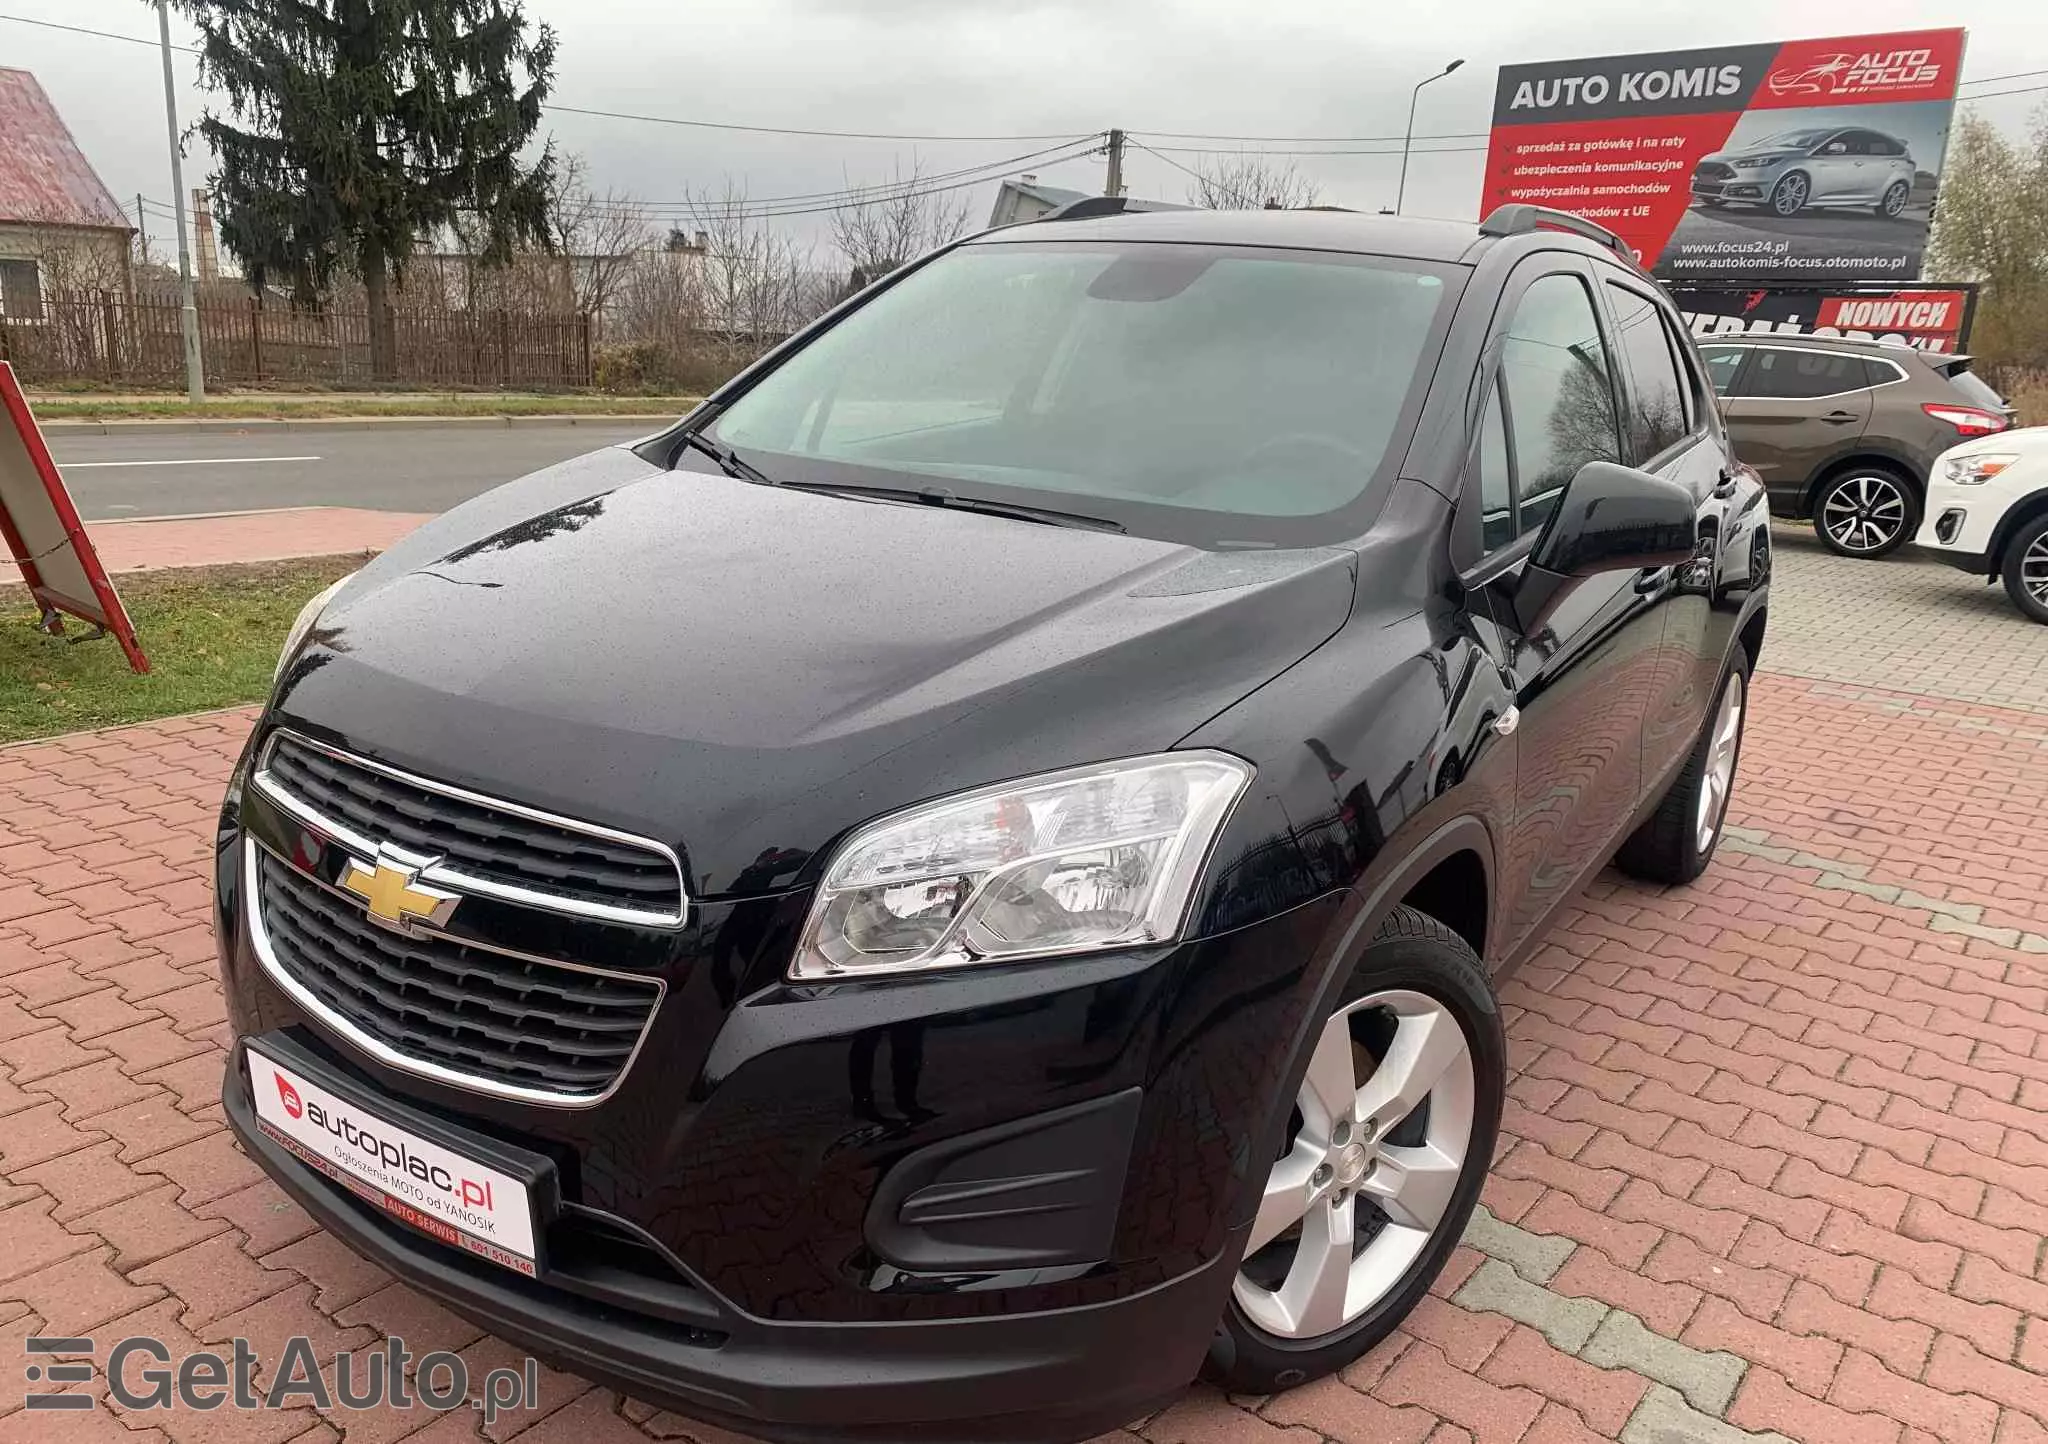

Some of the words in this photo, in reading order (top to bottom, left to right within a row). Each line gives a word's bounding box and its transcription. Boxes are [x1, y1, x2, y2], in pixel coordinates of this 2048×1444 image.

[1852, 49, 1932, 69] AUTO
[1843, 65, 1941, 86] FOCUS
[1510, 75, 1609, 110] AUTO
[1619, 65, 1742, 102] KOMIS
[1516, 141, 1566, 155] sprzedaż
[1568, 142, 1581, 152] za
[1583, 138, 1634, 153] gotówkę
[1636, 136, 1641, 148] i
[1643, 138, 1659, 148] na
[1661, 136, 1686, 149] raty
[1513, 162, 1592, 177] ubezpieczenia
[1594, 159, 1684, 173] komunikacyjne
[1511, 183, 1590, 199] wypożyczalnia
[1592, 182, 1671, 195] samochodów
[1567, 205, 1621, 218] ochodów
[1623, 207, 1629, 217] z
[1632, 205, 1650, 217] UE
[1681, 241, 1789, 255] www.focus24.pl
[1673, 255, 1907, 270] www.autokomis-focus.otomoto.pl
[1834, 301, 1952, 329] NOWYCH
[307, 1101, 494, 1212] autoplac.pl
[334, 1145, 389, 1184] Ogłoszenia
[392, 1175, 424, 1201] MOTO
[426, 1196, 441, 1210] od
[446, 1203, 496, 1235] YANOSIK
[385, 1199, 416, 1221] AUTO
[416, 1214, 456, 1241] SERWIS
[492, 1250, 511, 1266] 510
[514, 1260, 533, 1274] 140
